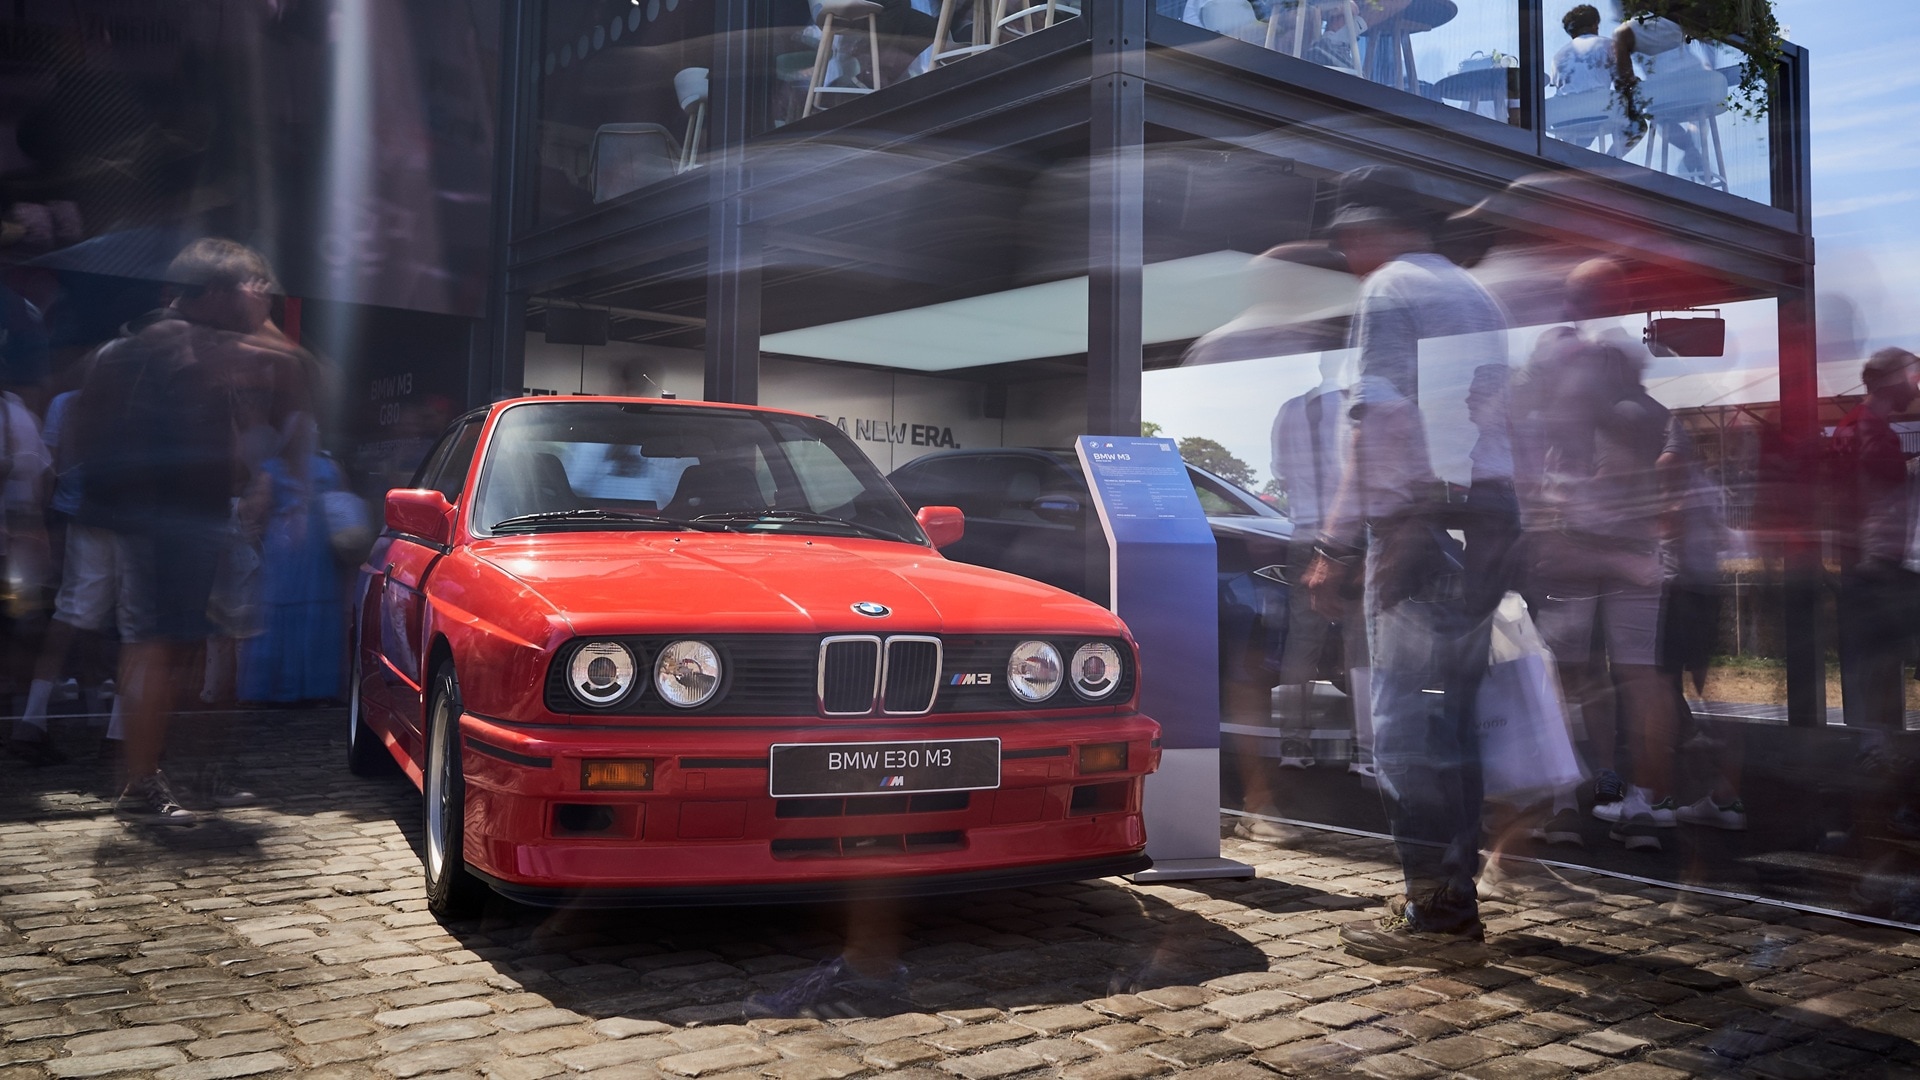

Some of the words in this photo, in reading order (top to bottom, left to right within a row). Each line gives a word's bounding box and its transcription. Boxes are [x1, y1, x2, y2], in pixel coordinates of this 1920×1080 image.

[370, 375, 396, 400] BMW
[397, 373, 413, 396] M3
[379, 402, 400, 425] G80
[856, 418, 907, 444] NEW
[911, 424, 961, 449] ERA.
[1117, 453, 1131, 461] M3
[961, 673, 992, 685] M3
[828, 751, 879, 770] BMW
[884, 750, 919, 768] E30
[925, 749, 951, 767] M3
